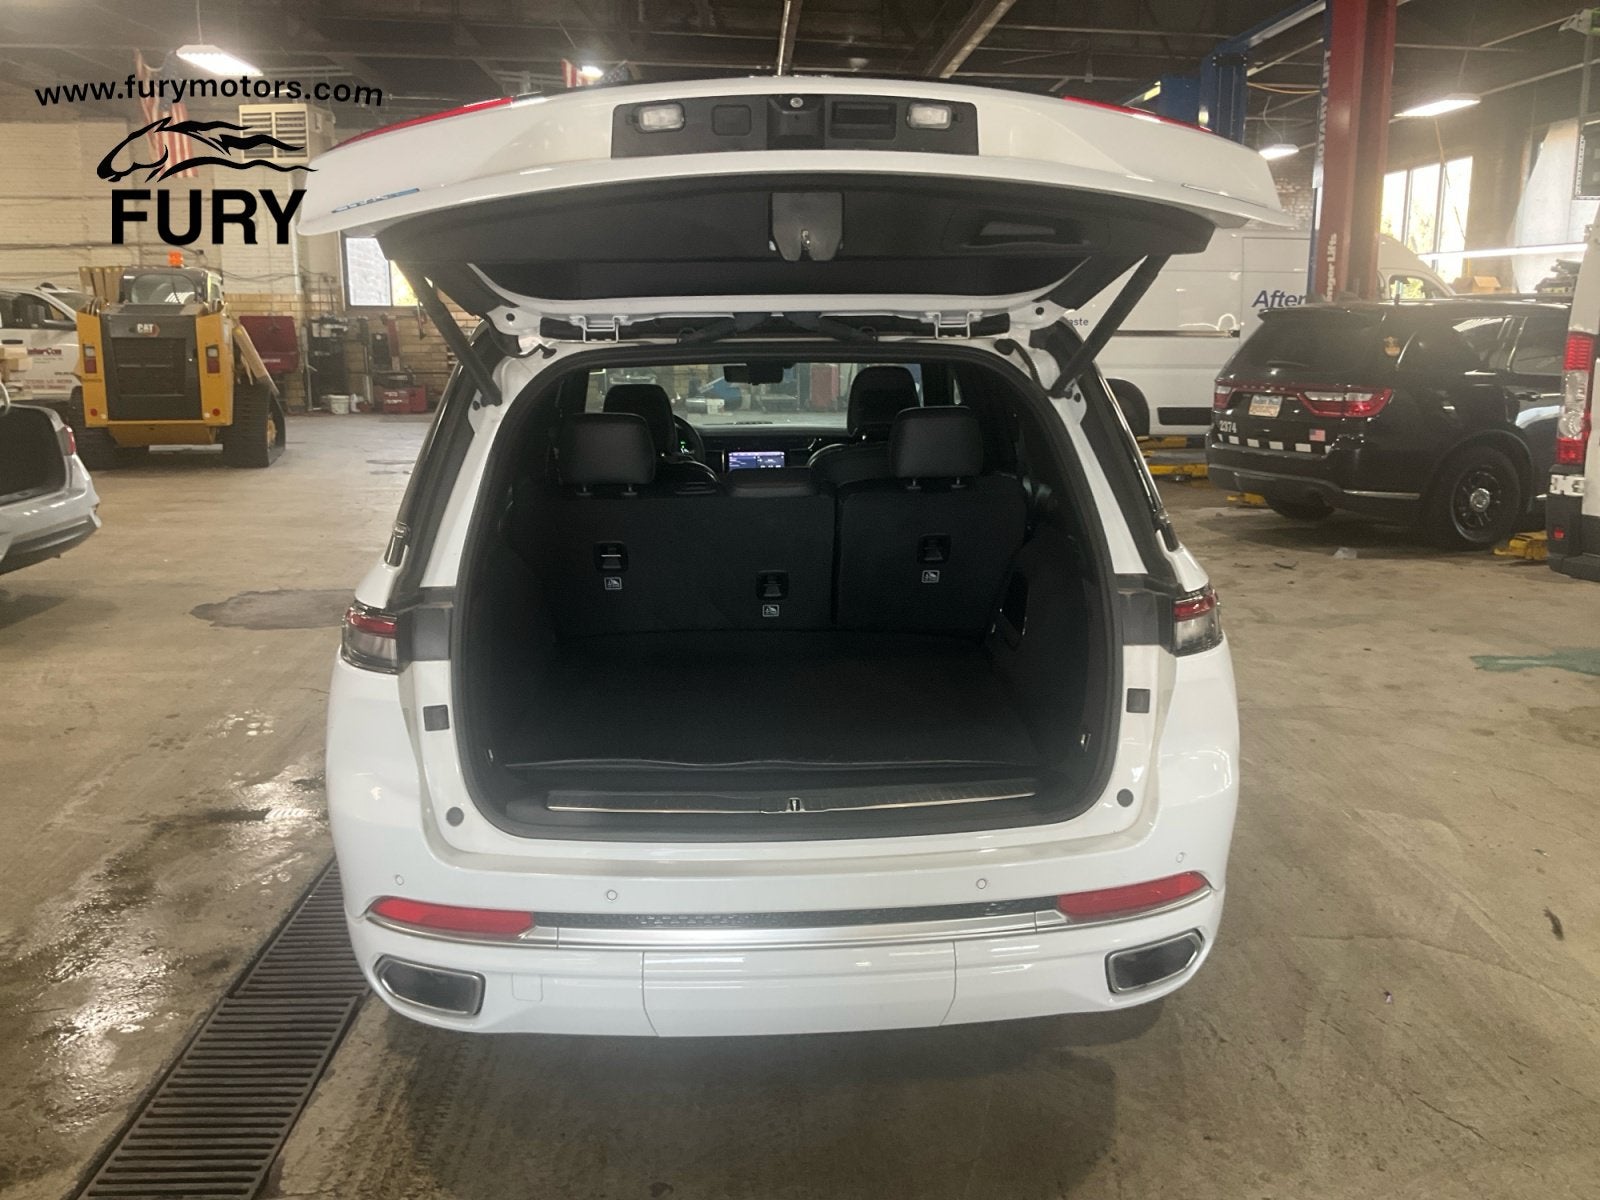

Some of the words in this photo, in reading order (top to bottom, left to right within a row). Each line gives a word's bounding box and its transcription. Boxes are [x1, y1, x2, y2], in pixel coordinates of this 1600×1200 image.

[1251, 290, 1307, 308] After
[137, 323, 154, 334] CAT
[1219, 420, 1237, 433] 2374
